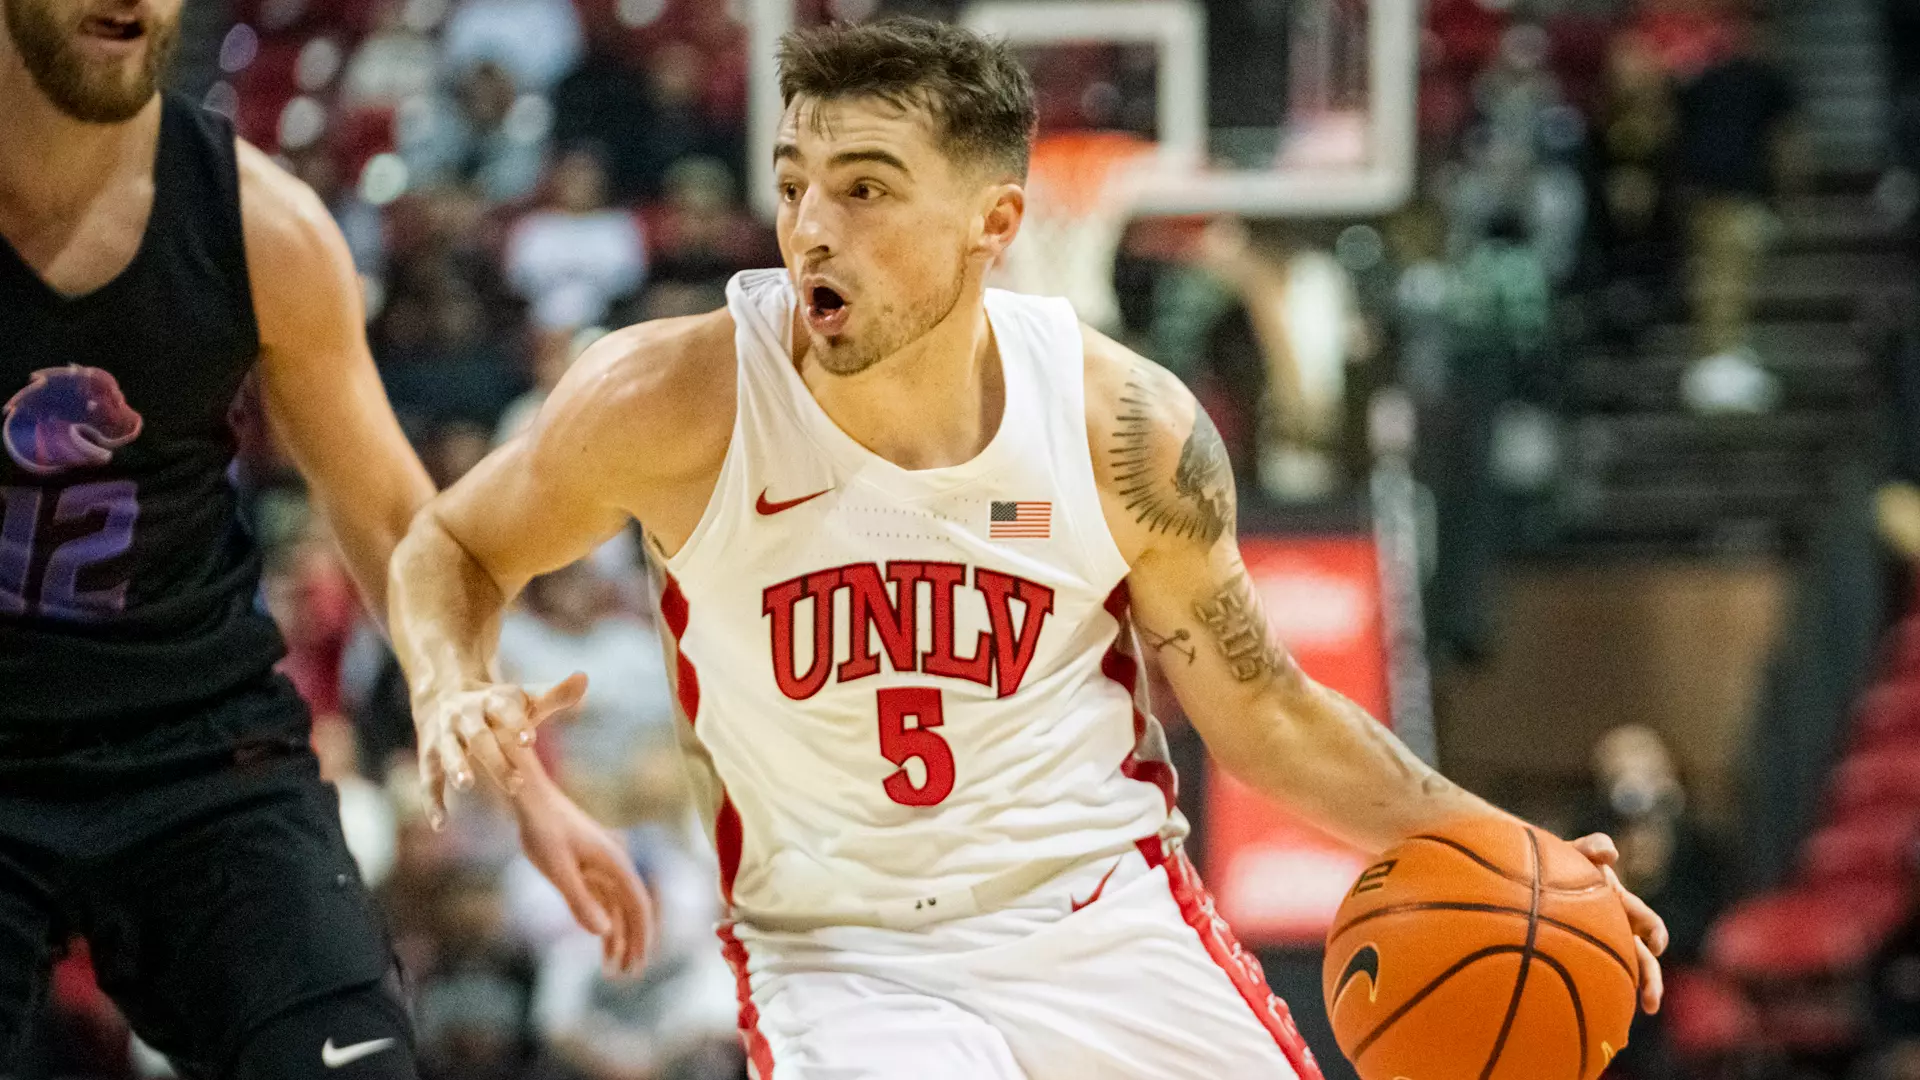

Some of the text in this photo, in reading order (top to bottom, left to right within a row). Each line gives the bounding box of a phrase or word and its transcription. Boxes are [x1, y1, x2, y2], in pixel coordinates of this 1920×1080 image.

[0, 480, 139, 614] 12
[761, 559, 1055, 701] UNLV
[876, 686, 956, 807] 5
